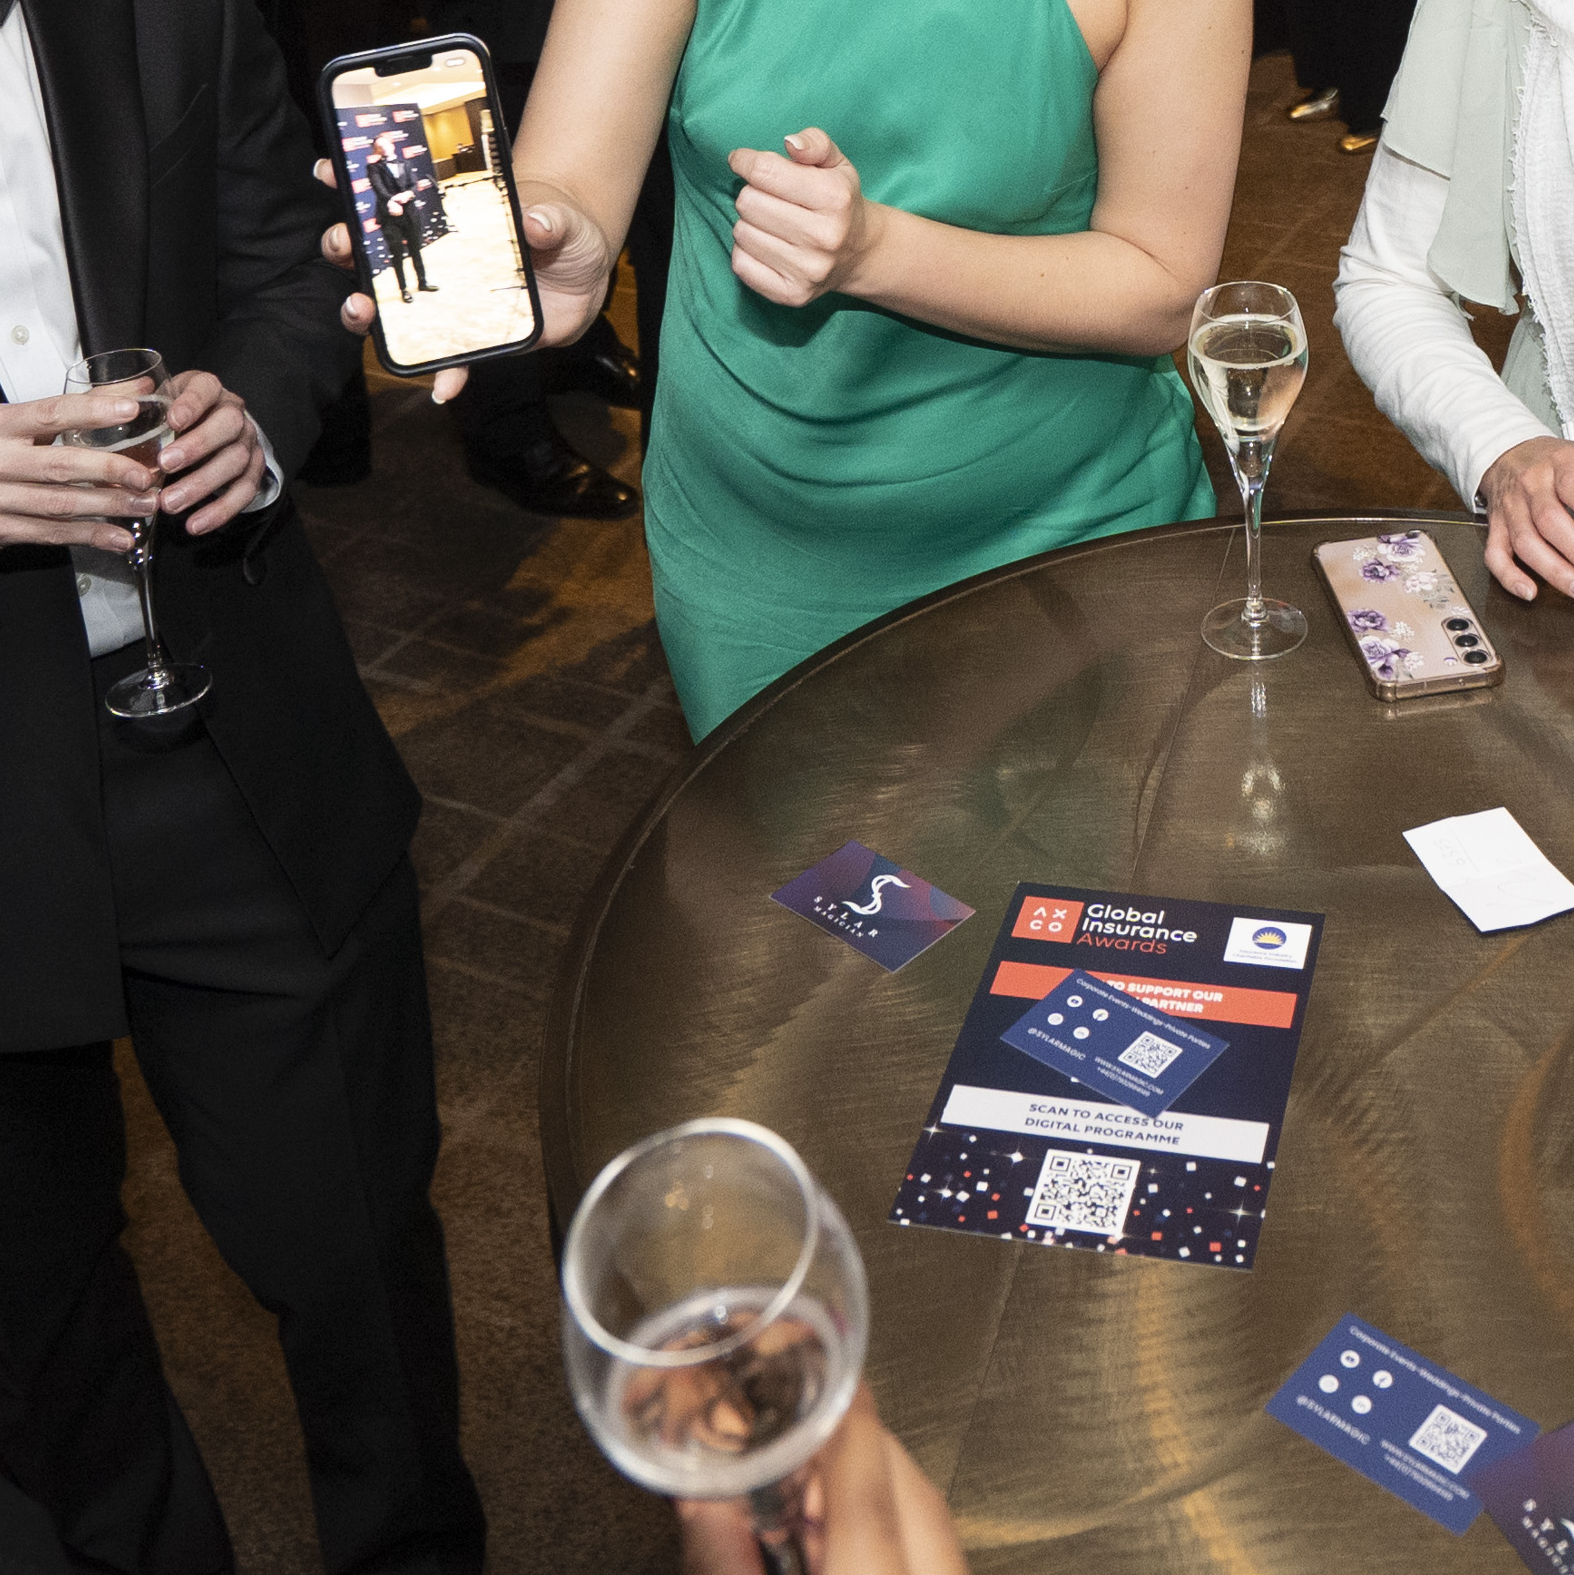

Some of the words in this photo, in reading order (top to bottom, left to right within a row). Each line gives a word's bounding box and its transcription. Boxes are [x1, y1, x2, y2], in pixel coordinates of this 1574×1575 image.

[814, 896, 879, 939] SYLAR
[814, 905, 864, 938] MAGICIAN
[1086, 903, 1165, 925] Global
[1076, 933, 1167, 955] Awards
[1081, 917, 1198, 943] Insurance
[1127, 982, 1191, 999] SUPPORT
[1192, 989, 1224, 1003] OUR
[1141, 997, 1204, 1014] PARTNER
[1076, 977, 1110, 999] Corporate
[1186, 1032, 1211, 1050] Parties
[1027, 1026, 1087, 1061] @SYLARMAGIC
[1024, 1117, 1081, 1134] DIGITAL
[1084, 1124, 1180, 1145] PROGRAMME
[1029, 1103, 1068, 1118] SCAN
[1072, 1108, 1091, 1120] TO
[1094, 1110, 1151, 1127] ACCESS
[1152, 1117, 1184, 1132] OUR
